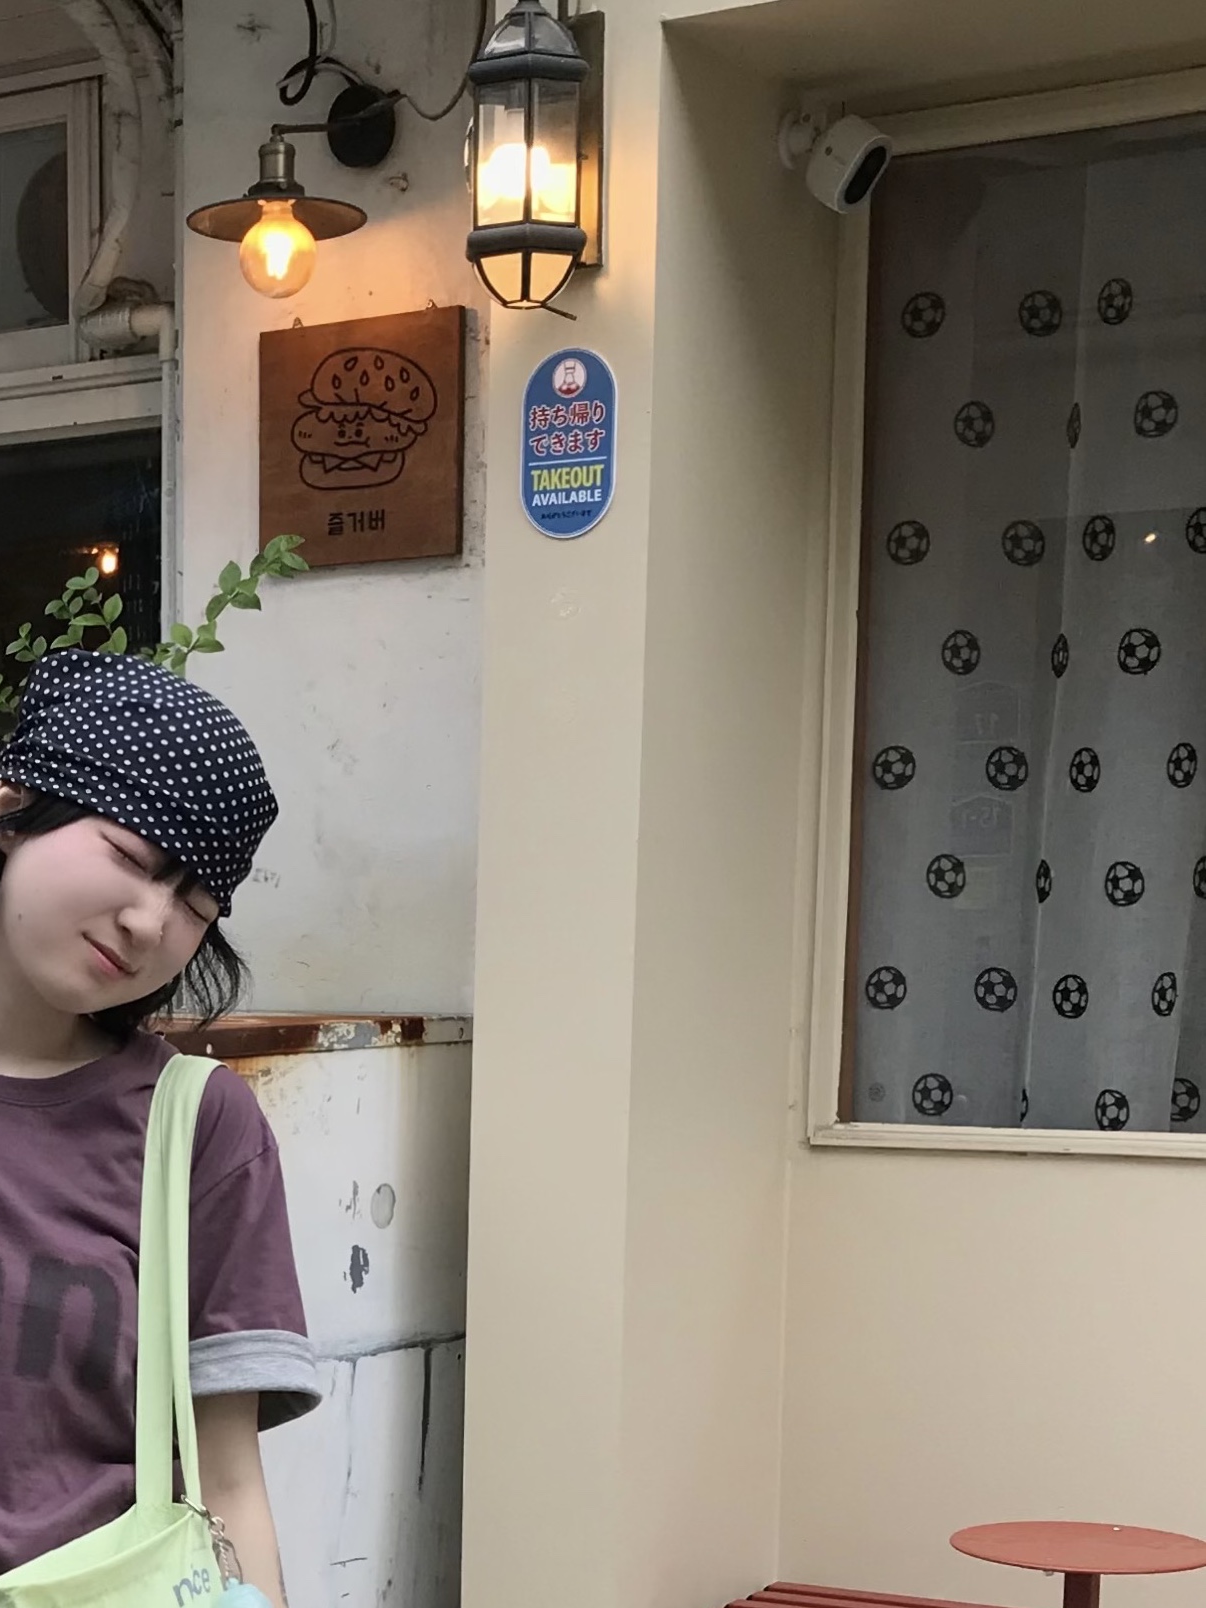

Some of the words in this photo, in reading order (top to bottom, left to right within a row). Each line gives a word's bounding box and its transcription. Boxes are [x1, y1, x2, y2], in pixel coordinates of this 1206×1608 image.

[529, 401, 606, 431] 持ち帰り
[529, 428, 606, 456] できます
[531, 464, 604, 492] TAKEOUT
[532, 488, 602, 507] AVAILABLE
[327, 509, 386, 536] 즐거버
[172, 1562, 211, 1608] nce
